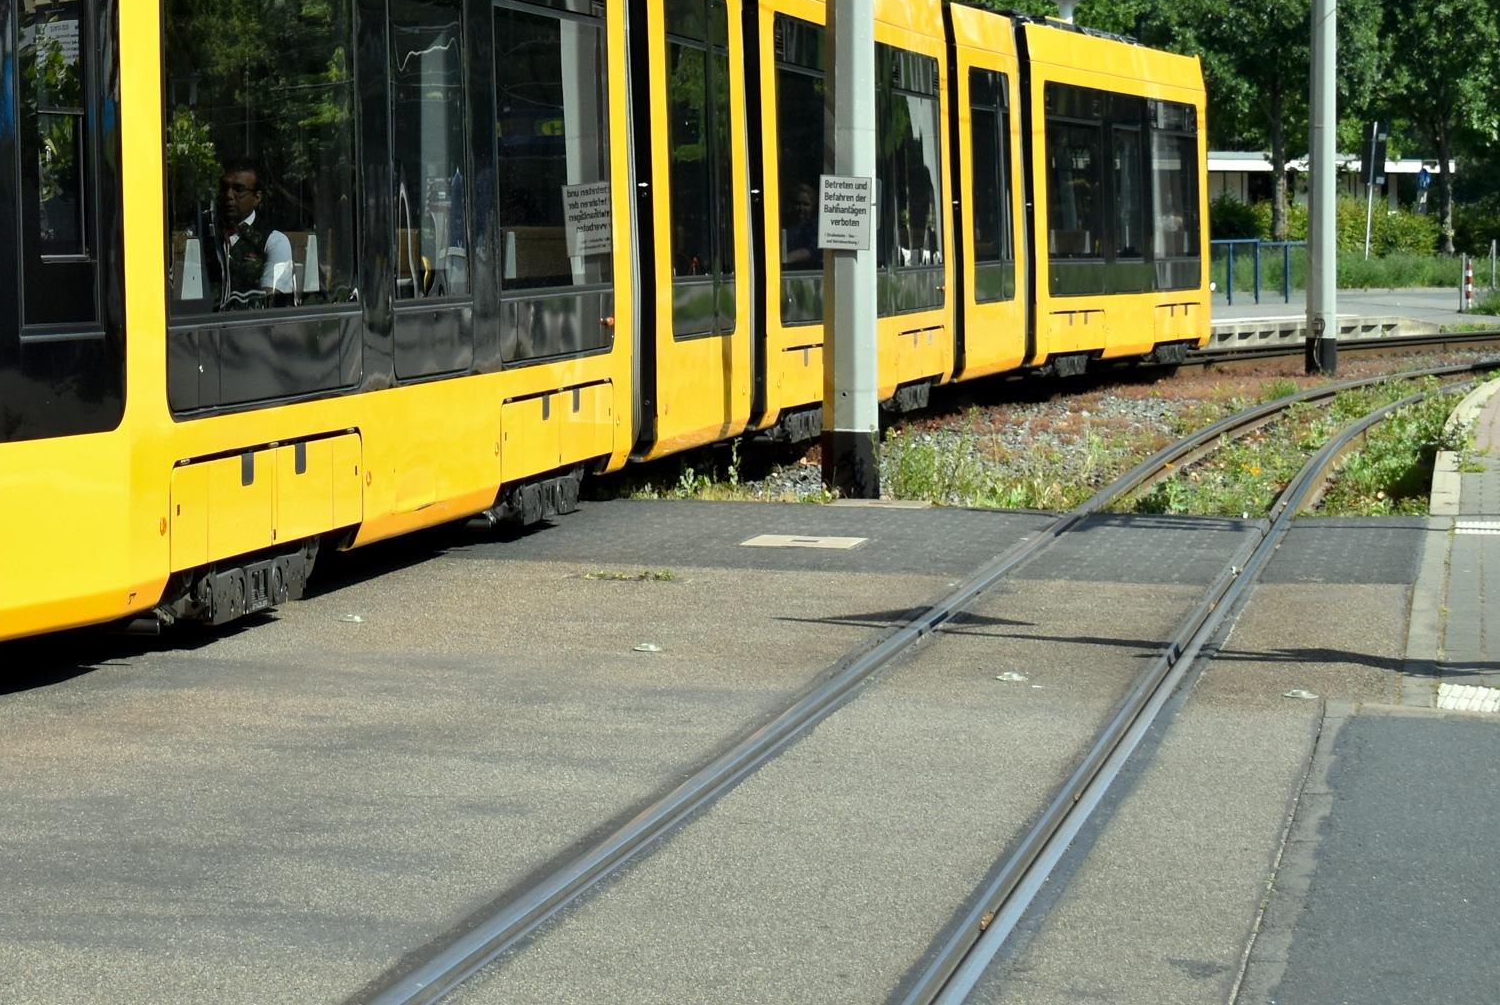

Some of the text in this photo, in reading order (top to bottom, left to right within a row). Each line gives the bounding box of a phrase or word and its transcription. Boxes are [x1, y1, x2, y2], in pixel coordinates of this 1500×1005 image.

[825, 180, 867, 190] Betreten und
[825, 192, 866, 202] Befahren der
[824, 204, 866, 216] Bahnanlagen
[831, 218, 860, 226] verboten
